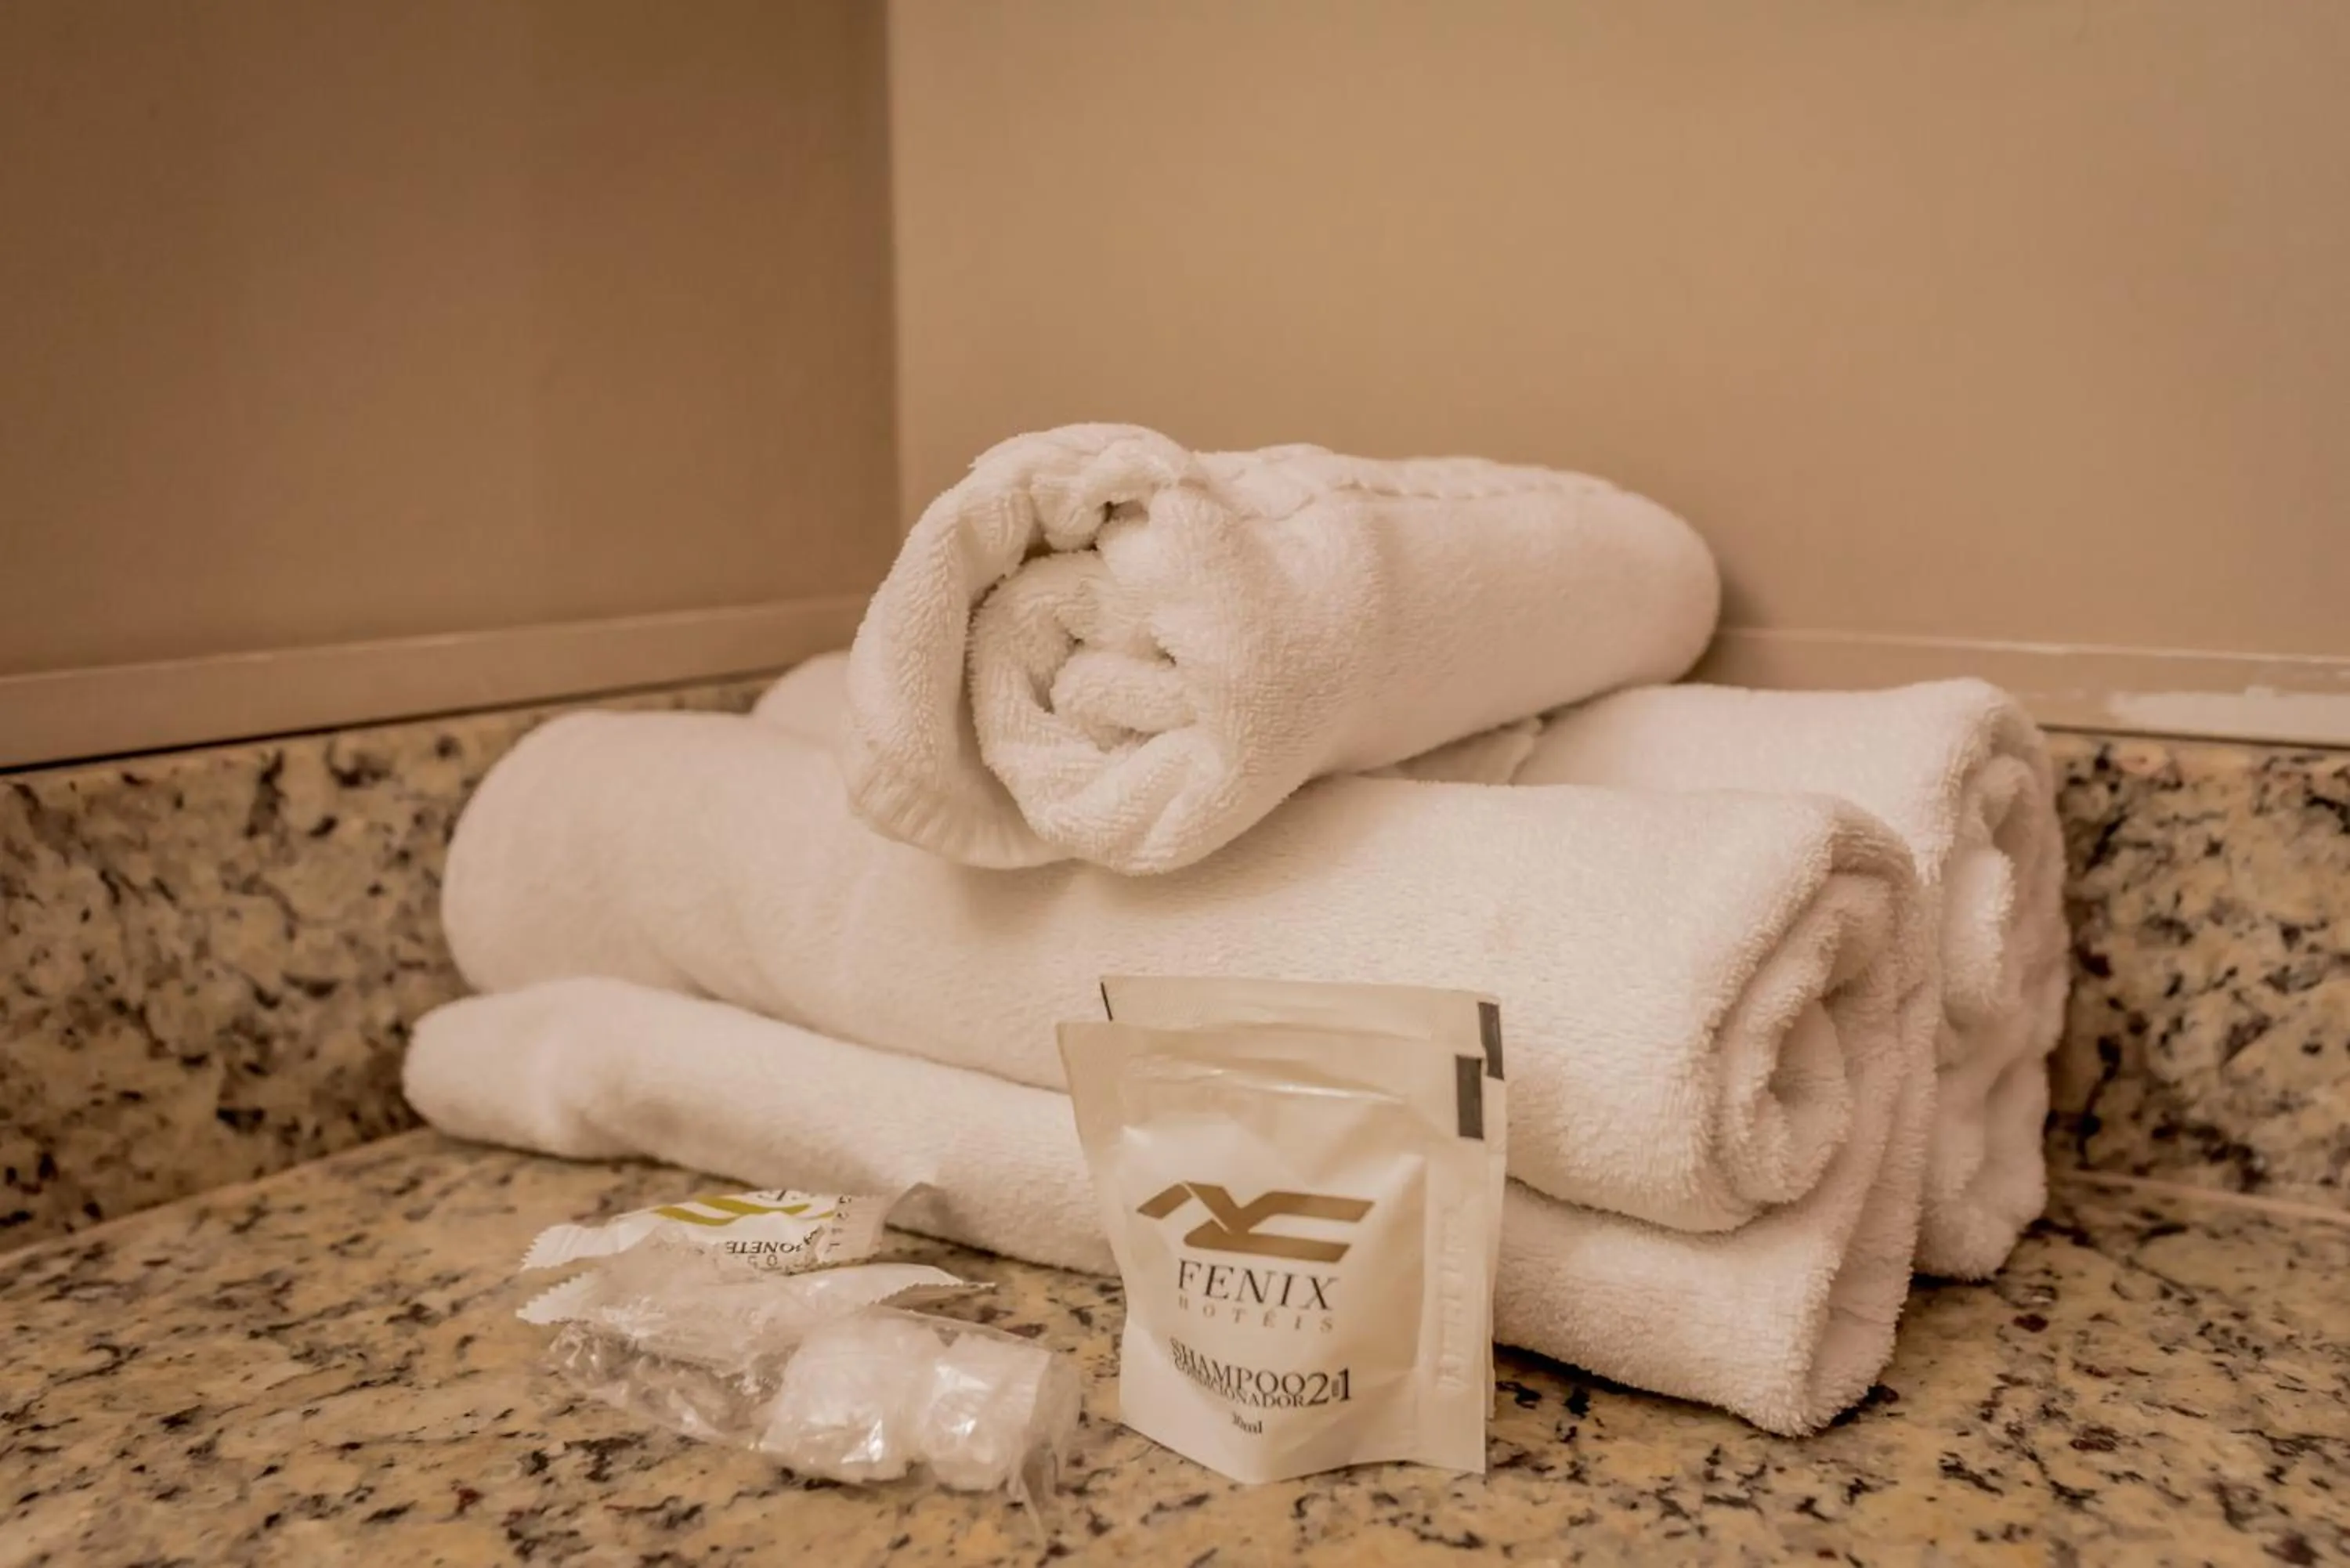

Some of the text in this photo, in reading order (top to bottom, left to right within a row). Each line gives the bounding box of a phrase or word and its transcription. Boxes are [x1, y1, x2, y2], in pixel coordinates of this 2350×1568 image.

[1177, 1259, 1339, 1310] FENIX
[1170, 1336, 1306, 1393] SHAMPOO
[1173, 1357, 1305, 1409] CIONADOR
